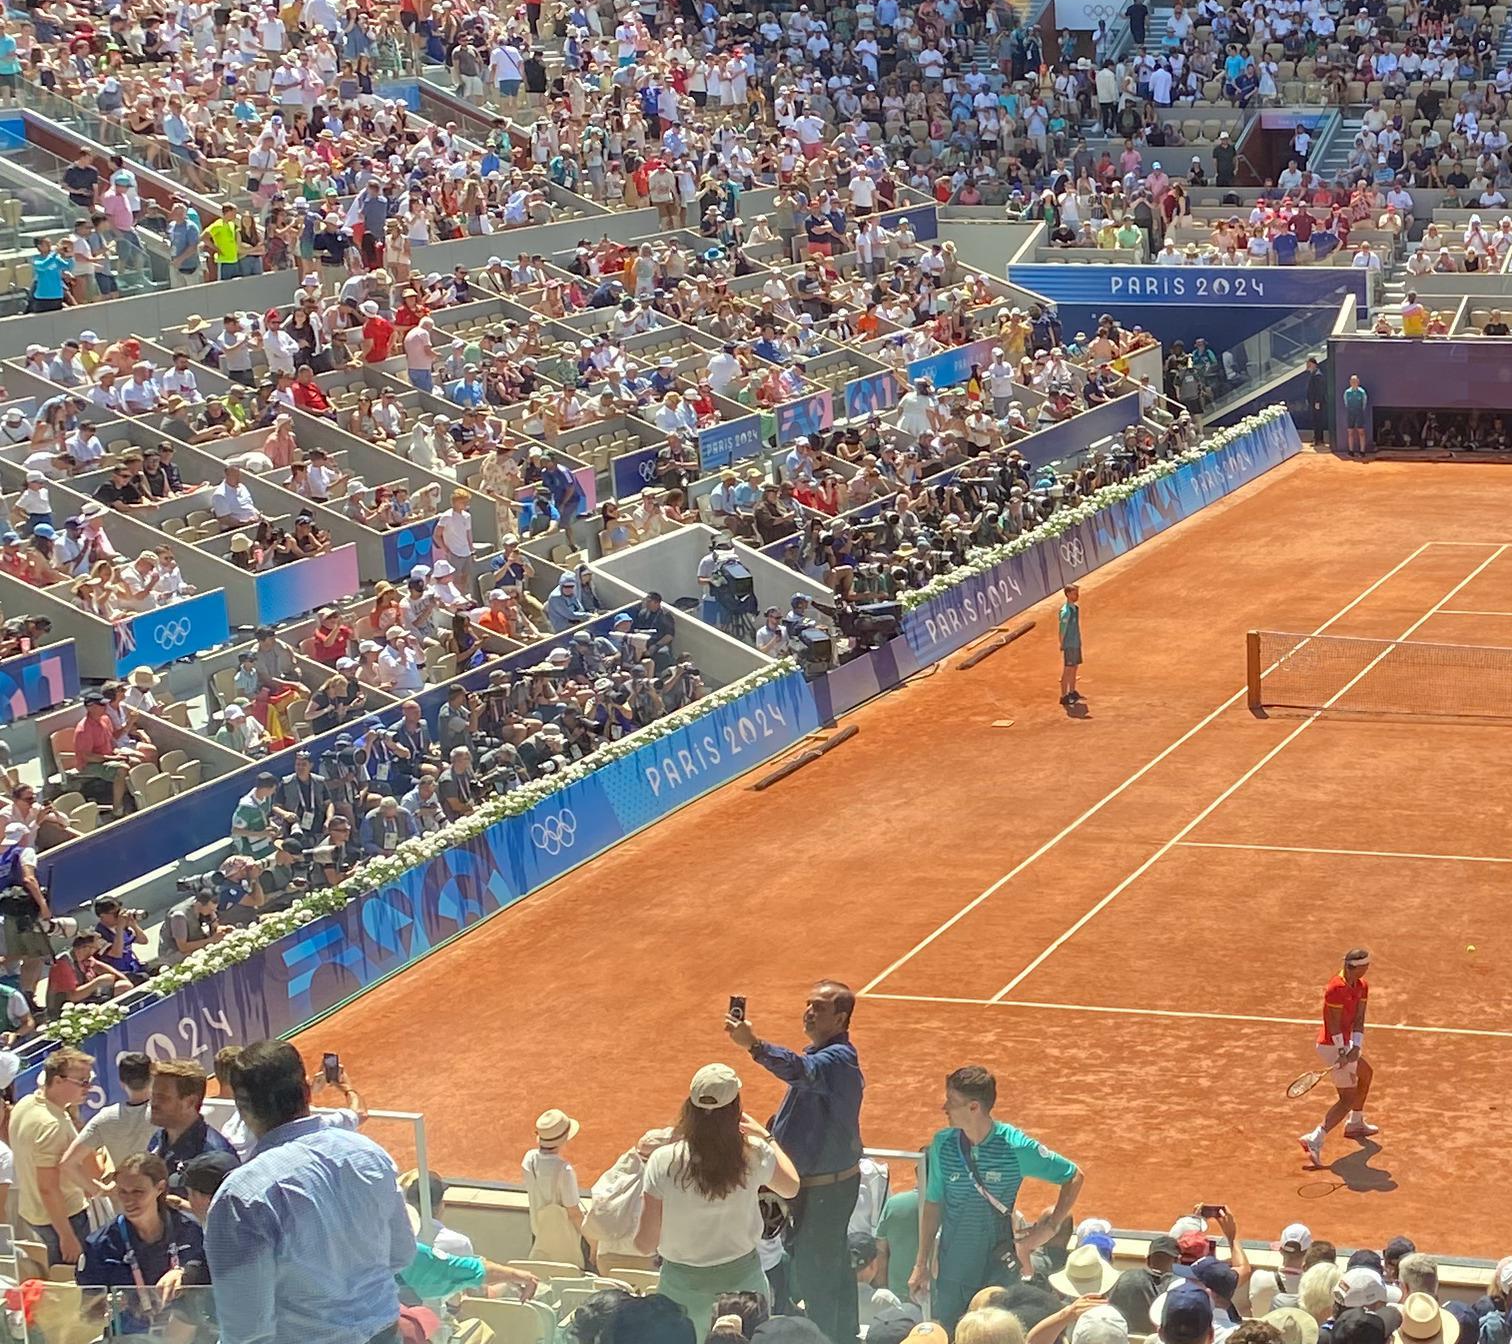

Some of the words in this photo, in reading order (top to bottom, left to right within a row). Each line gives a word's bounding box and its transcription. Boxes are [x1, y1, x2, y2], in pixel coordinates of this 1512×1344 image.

[1111, 276, 1185, 296] PARIS
[1196, 277, 1264, 297] 2024
[706, 436, 733, 457] PARIS
[734, 429, 758, 448] 2024
[1190, 465, 1226, 496] PARIS
[1222, 451, 1252, 480] 2024
[924, 598, 978, 645] PARIS
[976, 575, 1023, 616] 2024
[645, 735, 721, 797] PARIS
[723, 703, 787, 755] 2024
